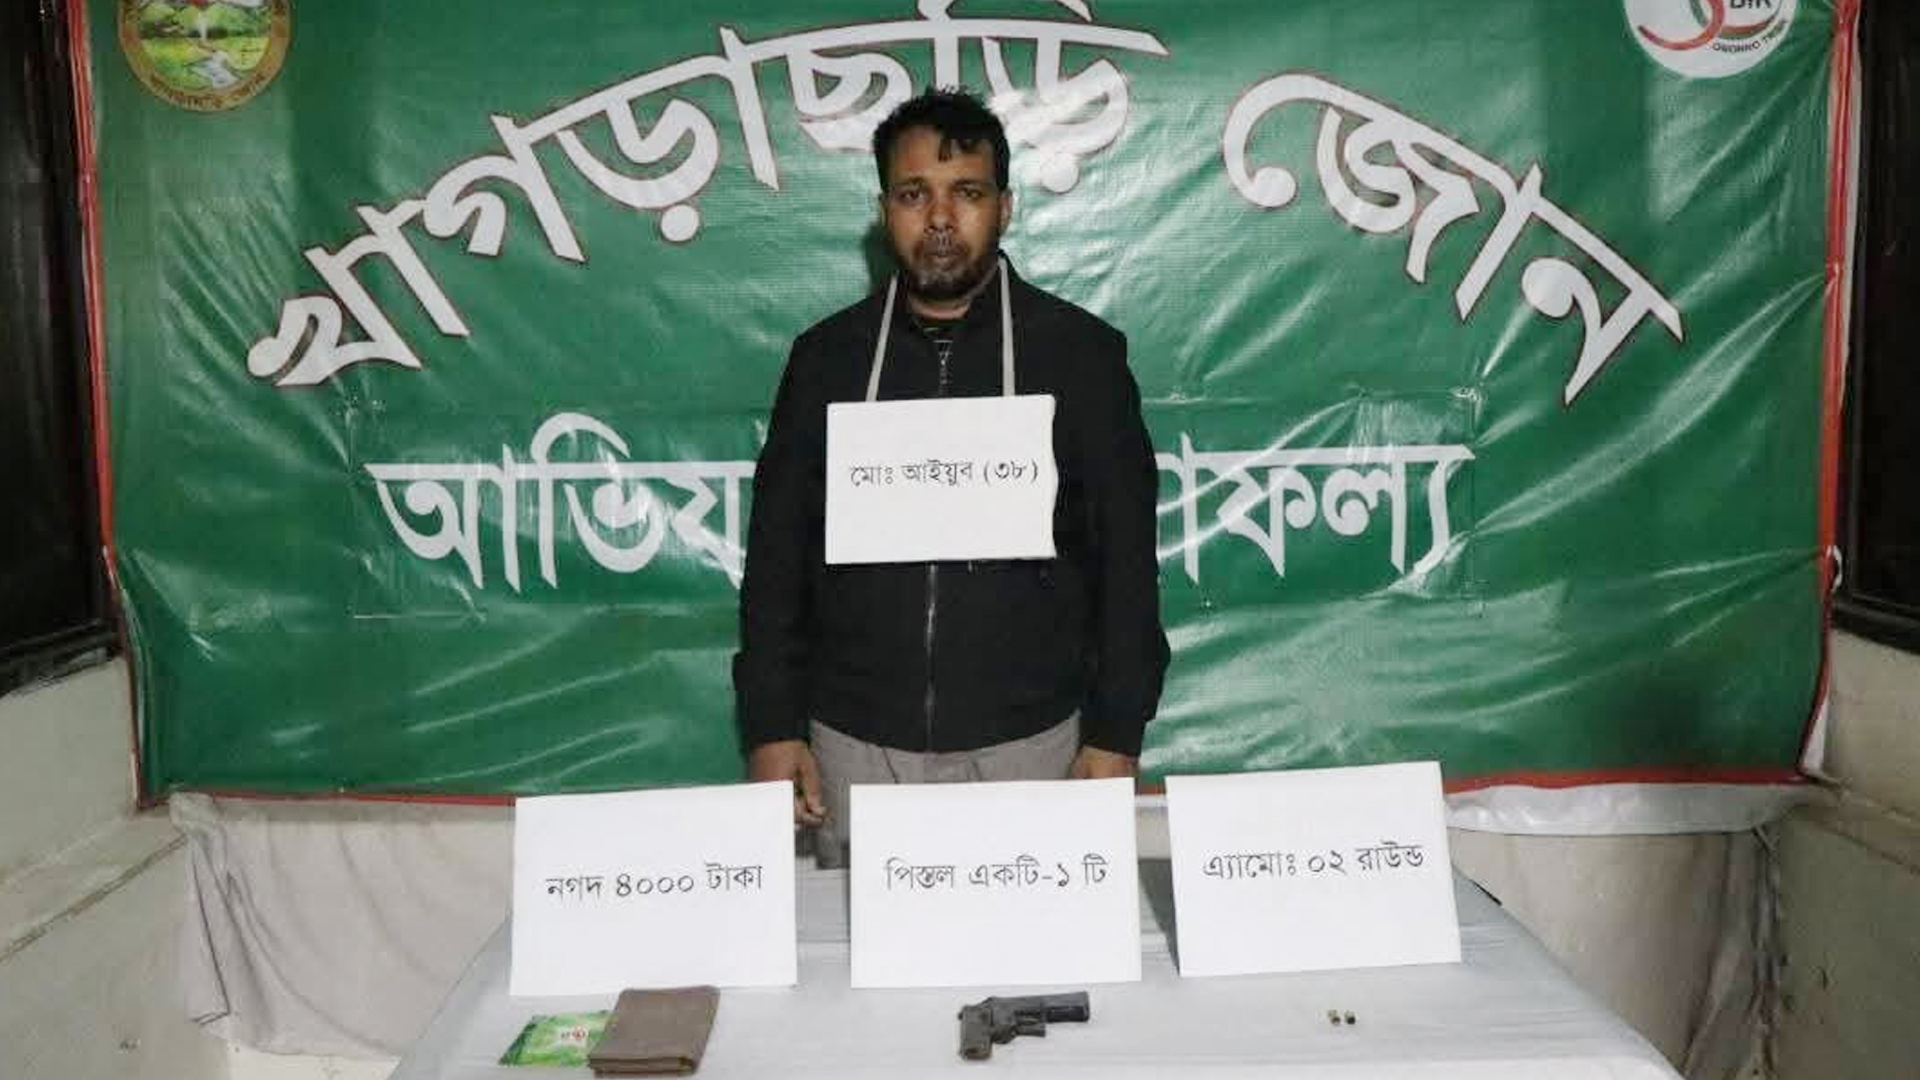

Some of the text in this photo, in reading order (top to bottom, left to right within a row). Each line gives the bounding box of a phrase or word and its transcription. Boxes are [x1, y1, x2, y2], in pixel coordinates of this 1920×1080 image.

[1222, 72, 1685, 406] জোন
[849, 464, 894, 487] মোঃ
[901, 458, 973, 486] আইয়ুব
[364, 412, 1475, 593] আভিয াফল্য
[885, 856, 955, 890] পিস্তল
[1082, 853, 1108, 884] টি
[1307, 850, 1347, 875] ০২
[1355, 840, 1425, 871] রাউন্ড
[546, 861, 763, 901] নগদ ৪০০০ টাকা
